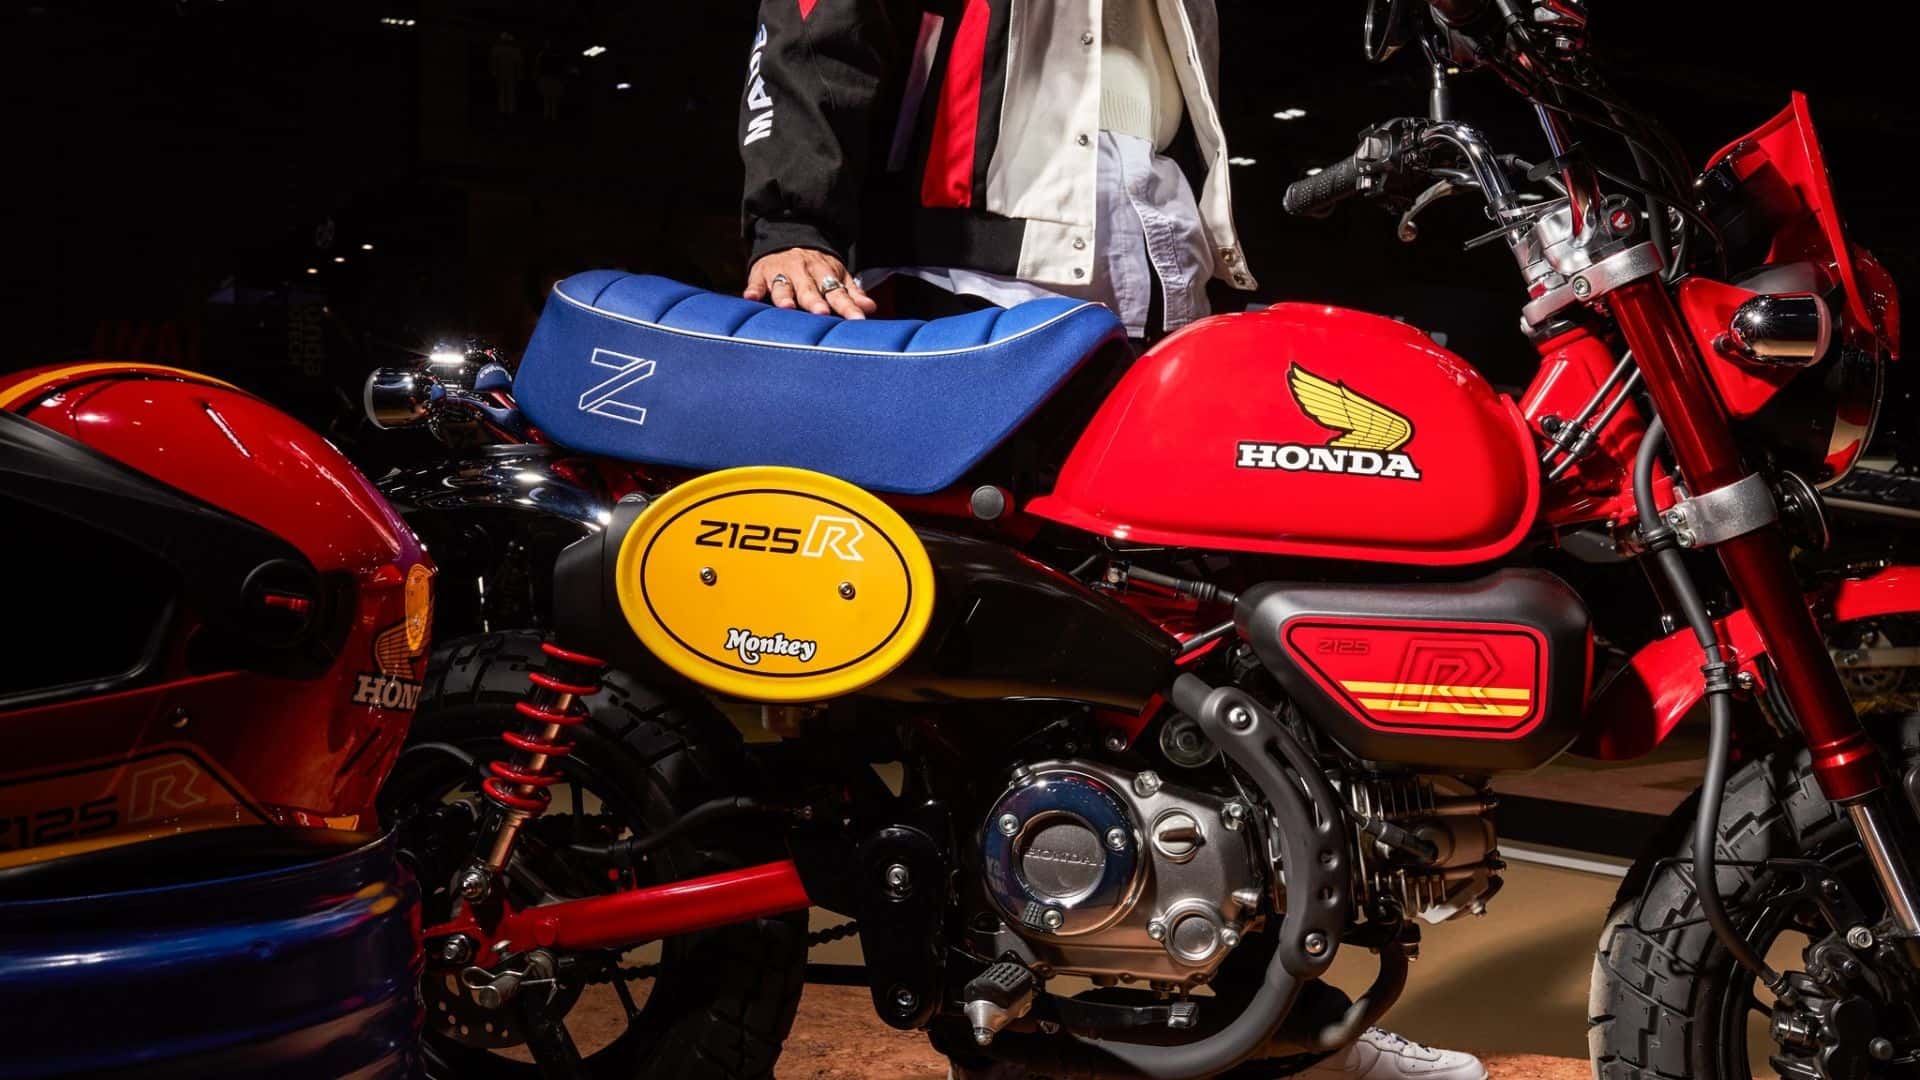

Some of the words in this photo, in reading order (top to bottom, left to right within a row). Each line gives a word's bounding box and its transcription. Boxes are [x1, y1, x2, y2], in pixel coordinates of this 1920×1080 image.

[578, 348, 656, 425] Z
[1237, 443, 1420, 480] HONDA
[725, 629, 816, 665] Monkey
